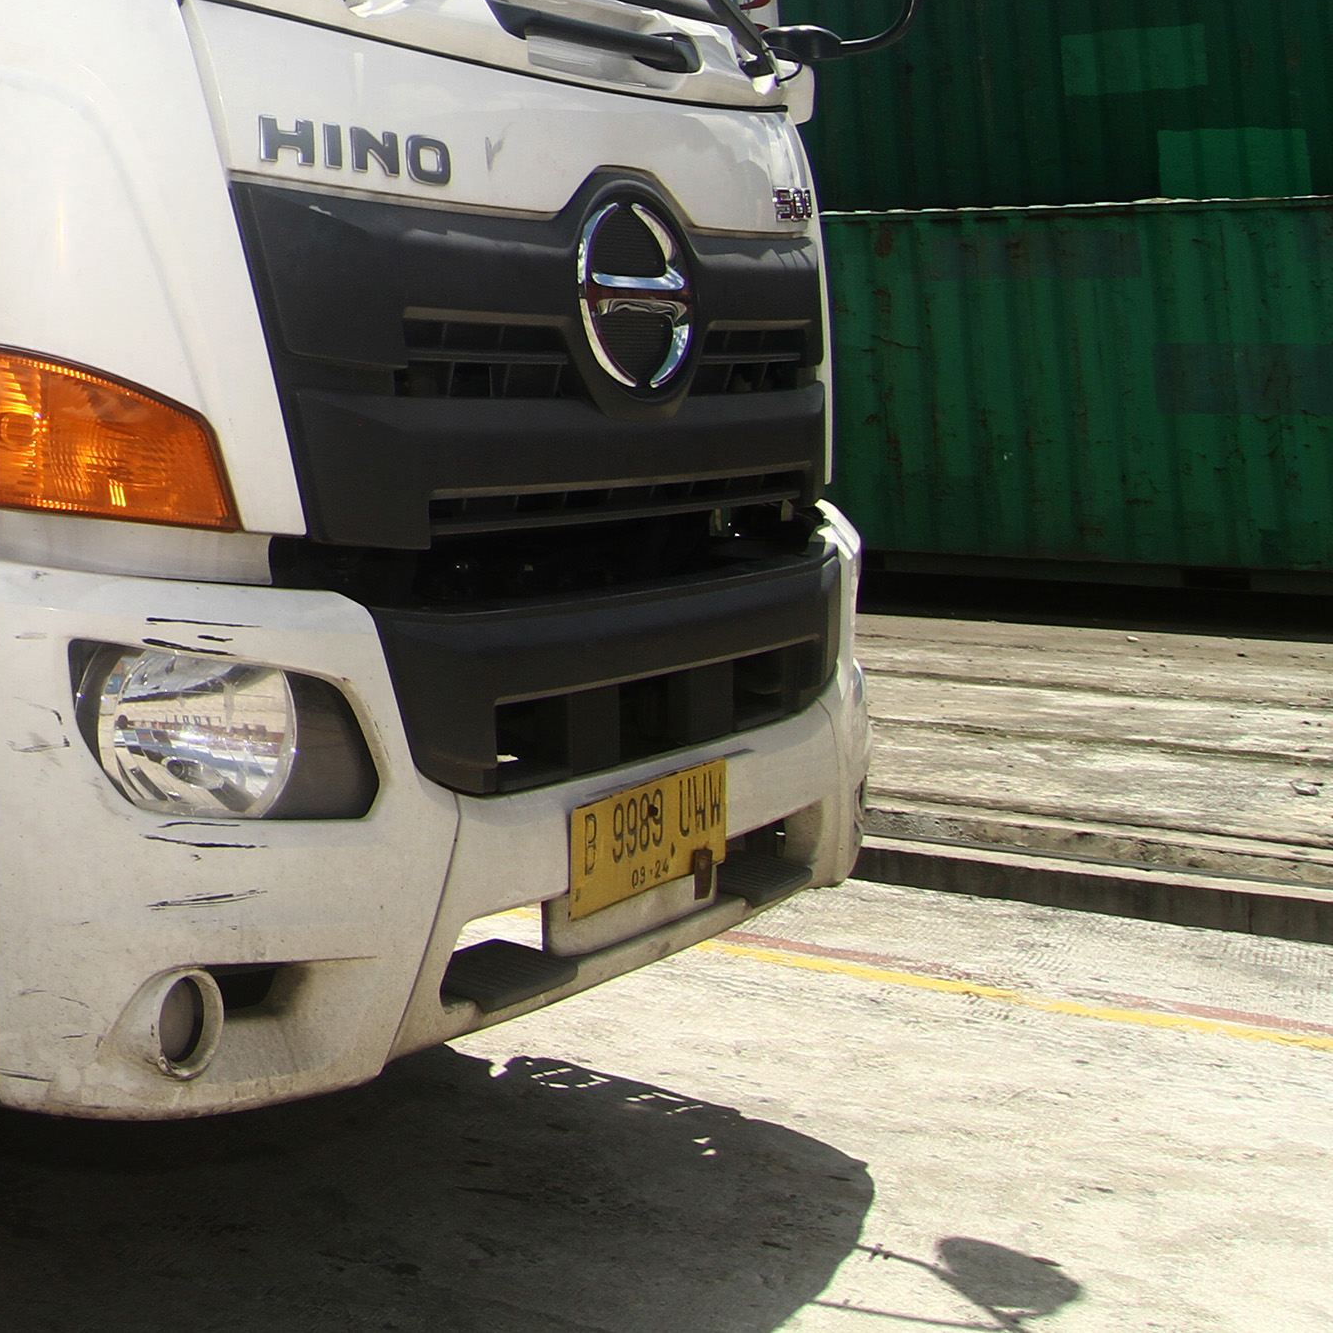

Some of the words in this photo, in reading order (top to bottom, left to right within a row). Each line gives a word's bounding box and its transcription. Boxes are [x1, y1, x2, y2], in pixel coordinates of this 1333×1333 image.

[257, 113, 451, 185] HINO
[584, 812, 597, 876] B
[612, 787, 664, 864] 9989
[678, 769, 723, 838] UWW
